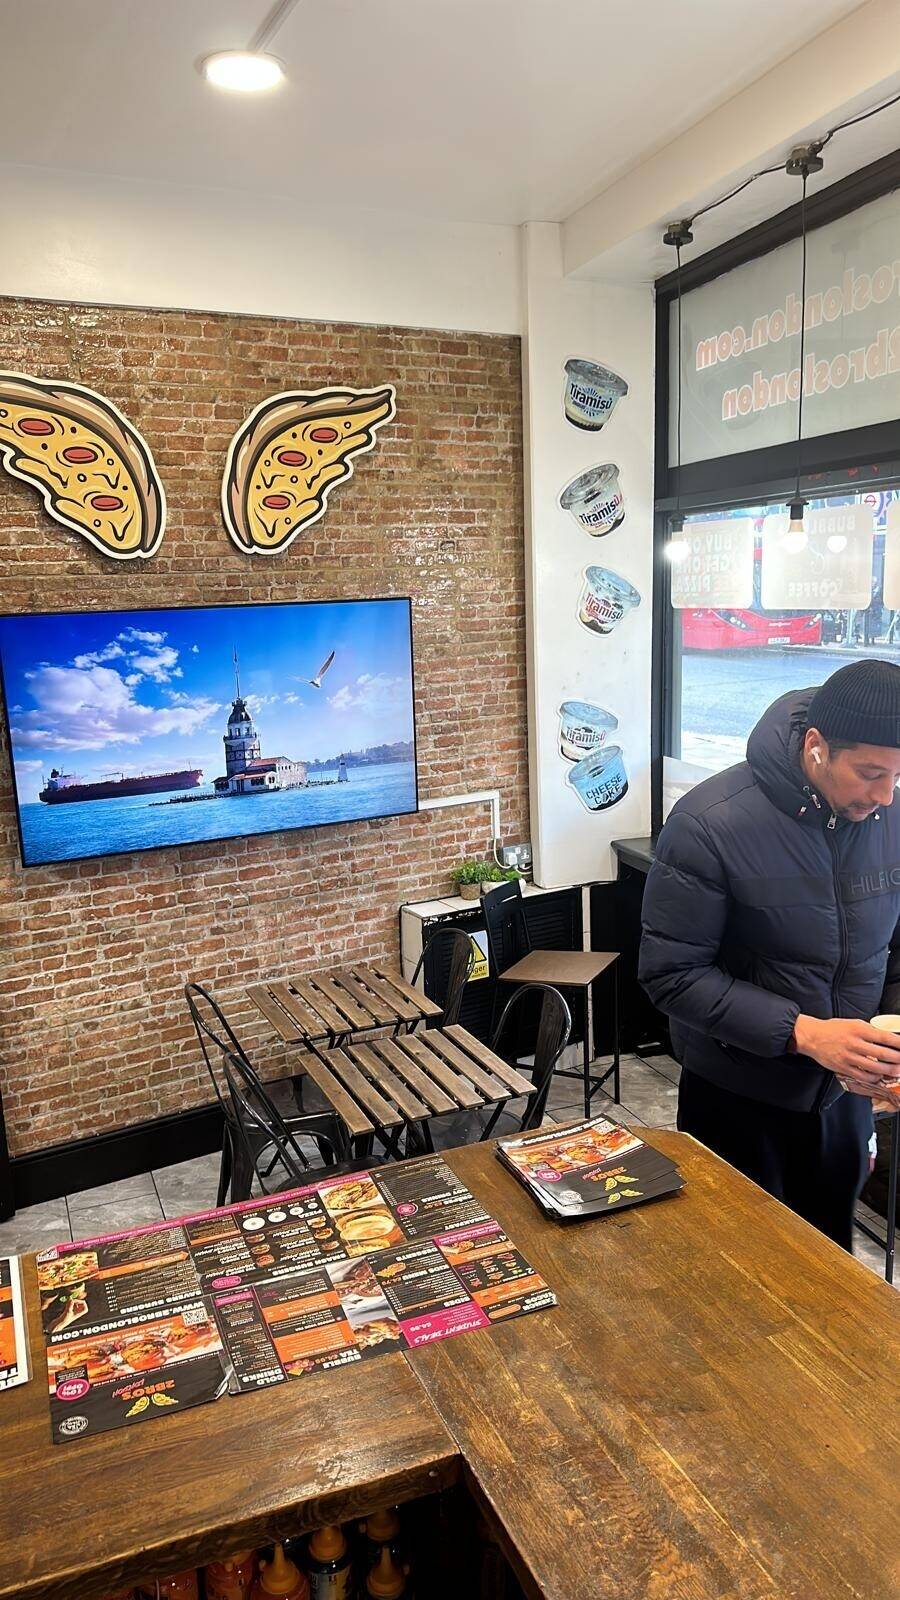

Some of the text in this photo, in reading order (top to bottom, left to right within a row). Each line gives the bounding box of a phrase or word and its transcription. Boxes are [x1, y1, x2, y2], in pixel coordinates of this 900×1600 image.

[586, 773, 622, 799] CHEESE
[298, 1209, 322, 1219] PIZZA
[272, 1253, 346, 1276] SMASH BURGERS
[428, 1263, 449, 1273] KIDS
[402, 1270, 428, 1280] MENU
[120, 1299, 164, 1315] BURGERS
[443, 1296, 471, 1307] SIDES
[415, 1319, 482, 1343] STUDENT DEALS
[242, 1368, 282, 1383] DRINKS
[256, 1374, 284, 1386] COLD
[120, 1379, 176, 1402] 2BRO'S
